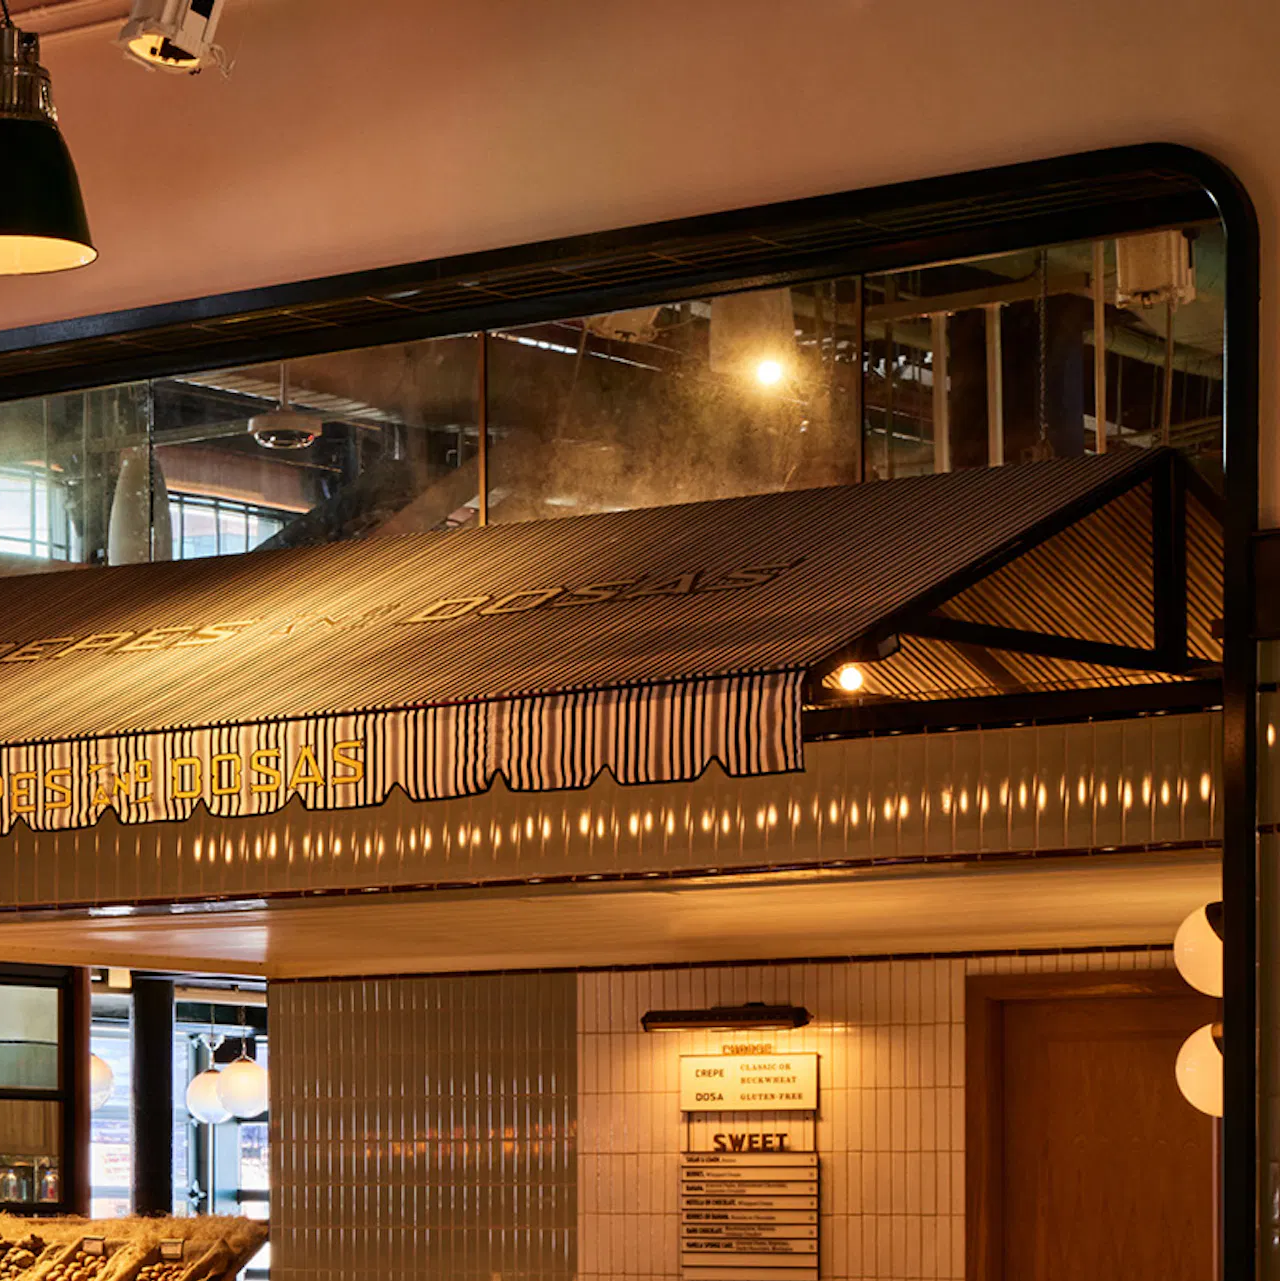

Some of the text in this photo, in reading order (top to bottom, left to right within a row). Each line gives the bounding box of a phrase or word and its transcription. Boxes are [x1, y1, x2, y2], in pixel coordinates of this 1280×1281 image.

[91, 759, 153, 806] AND
[170, 741, 364, 799] DOSAS
[695, 1069, 724, 1078] CREPE
[695, 1093, 724, 1101] DOSA
[713, 1133, 788, 1152] SWEET
